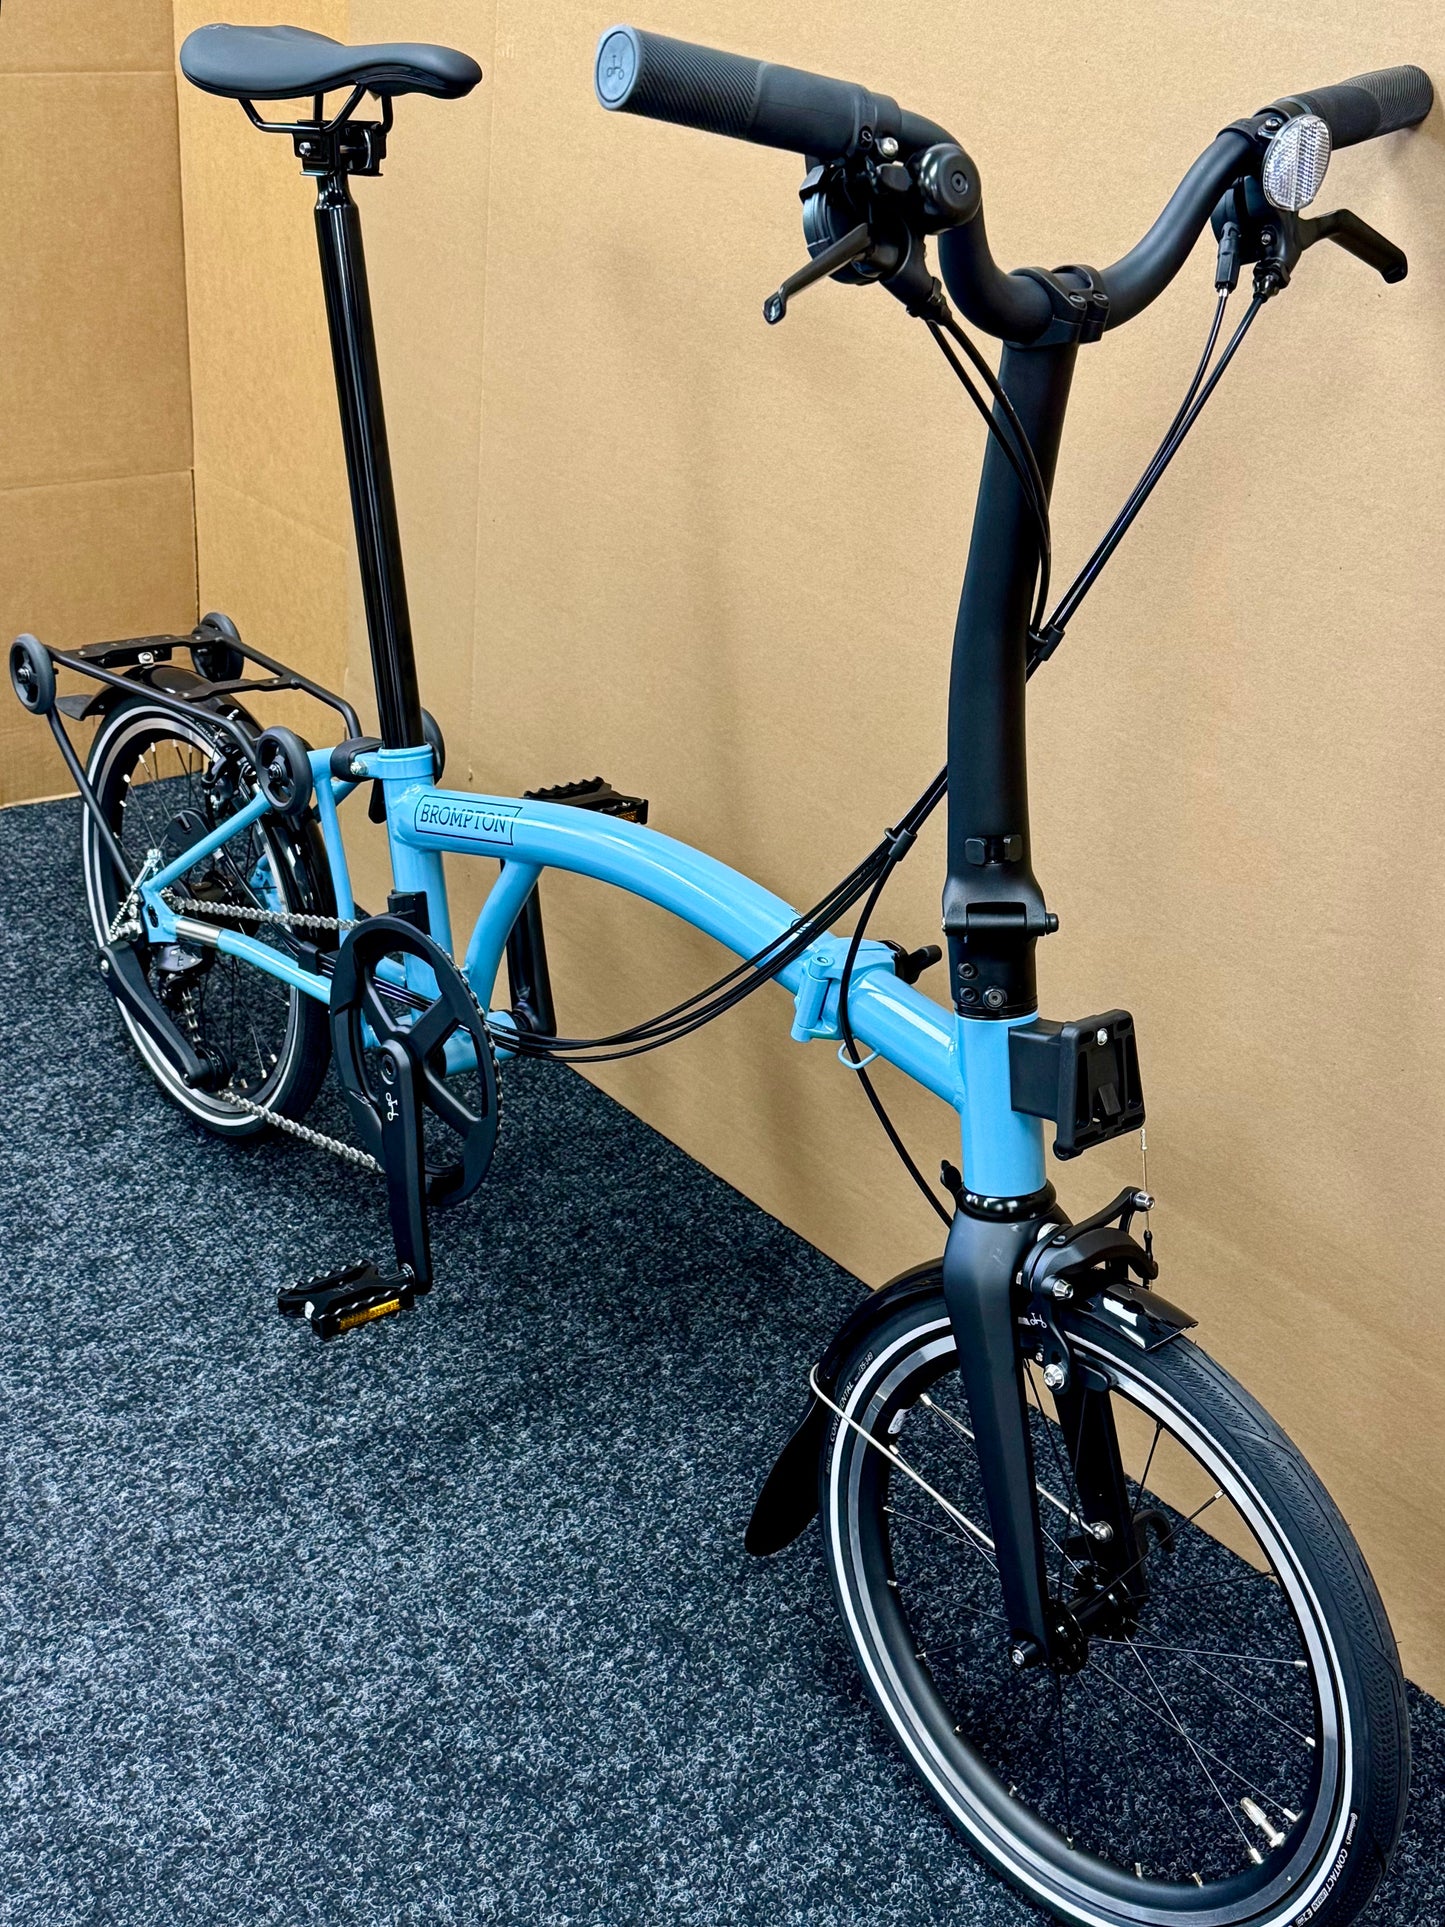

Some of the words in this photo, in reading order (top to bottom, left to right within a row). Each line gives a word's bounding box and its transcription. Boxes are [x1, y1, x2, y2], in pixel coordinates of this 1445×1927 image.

[420, 803, 509, 833] BROMPTON
[830, 1381, 854, 1442] CONTENTAL
[1326, 1848, 1348, 1892] CONTACT
